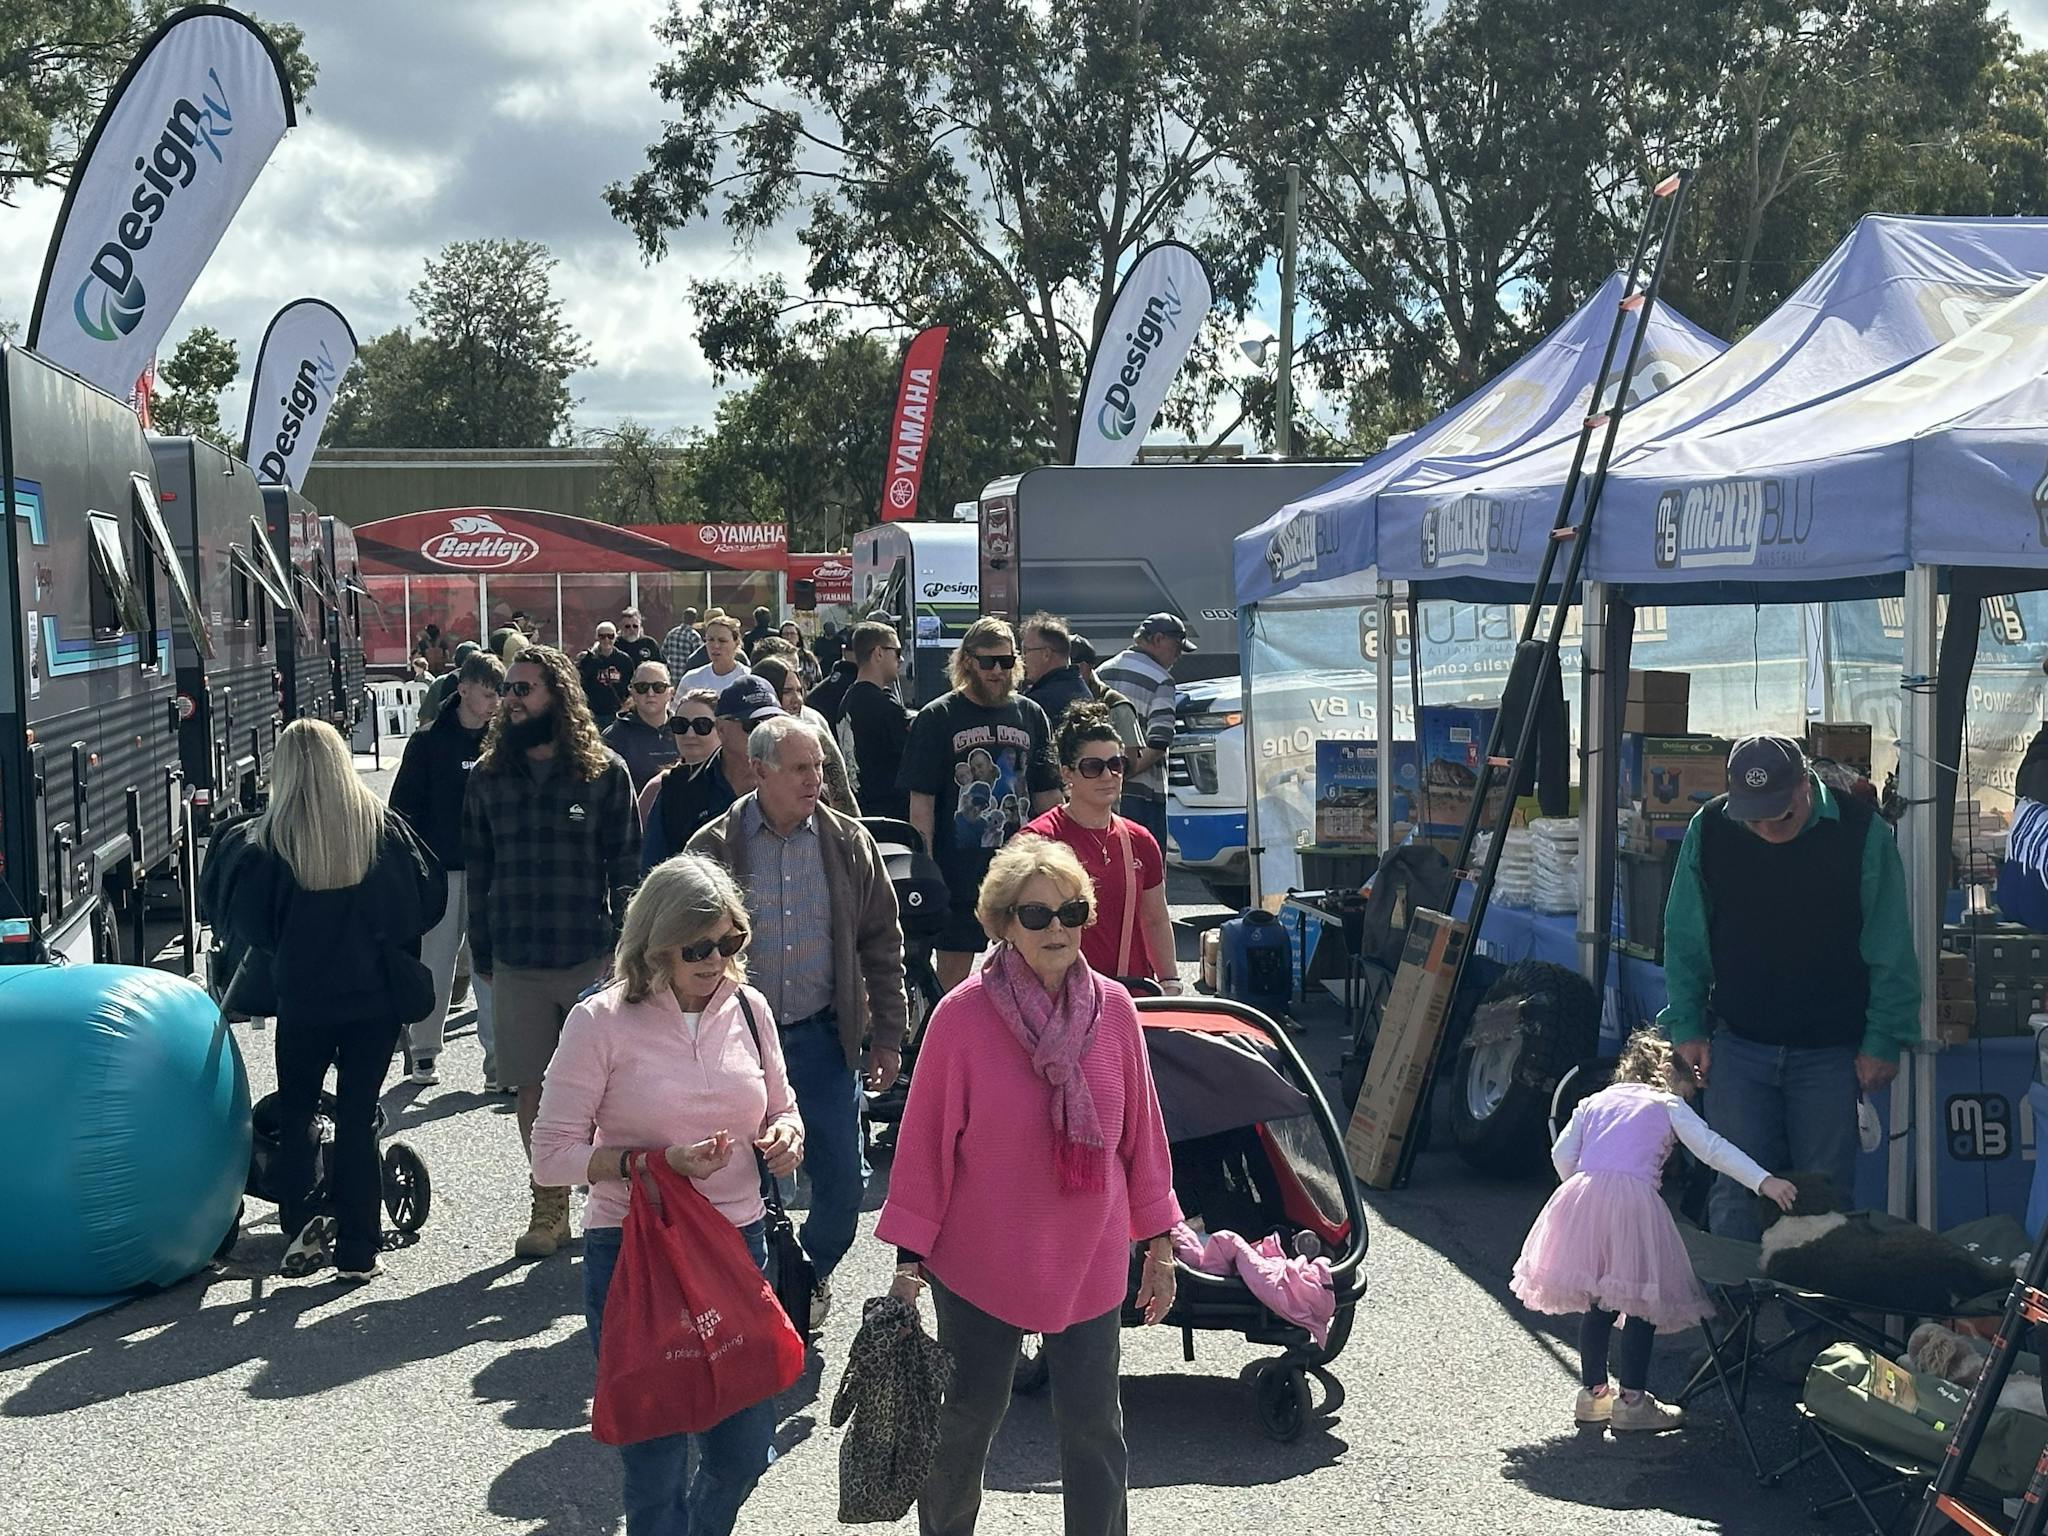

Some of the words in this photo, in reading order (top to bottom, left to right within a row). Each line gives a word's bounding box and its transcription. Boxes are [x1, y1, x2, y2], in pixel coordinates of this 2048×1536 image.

[90, 98, 201, 294] Design
[194, 67, 233, 164] RV
[1105, 296, 1165, 413] Design
[1161, 275, 1183, 331] RV
[259, 359, 318, 483] Design
[314, 339, 336, 398] RV
[894, 368, 933, 475] YAMAHA
[718, 525, 786, 543] YAMAHA
[435, 537, 527, 563] Berkley
[822, 592, 851, 601] YAMAHA
[934, 582, 978, 595] Design
[952, 726, 996, 752] GIRL
